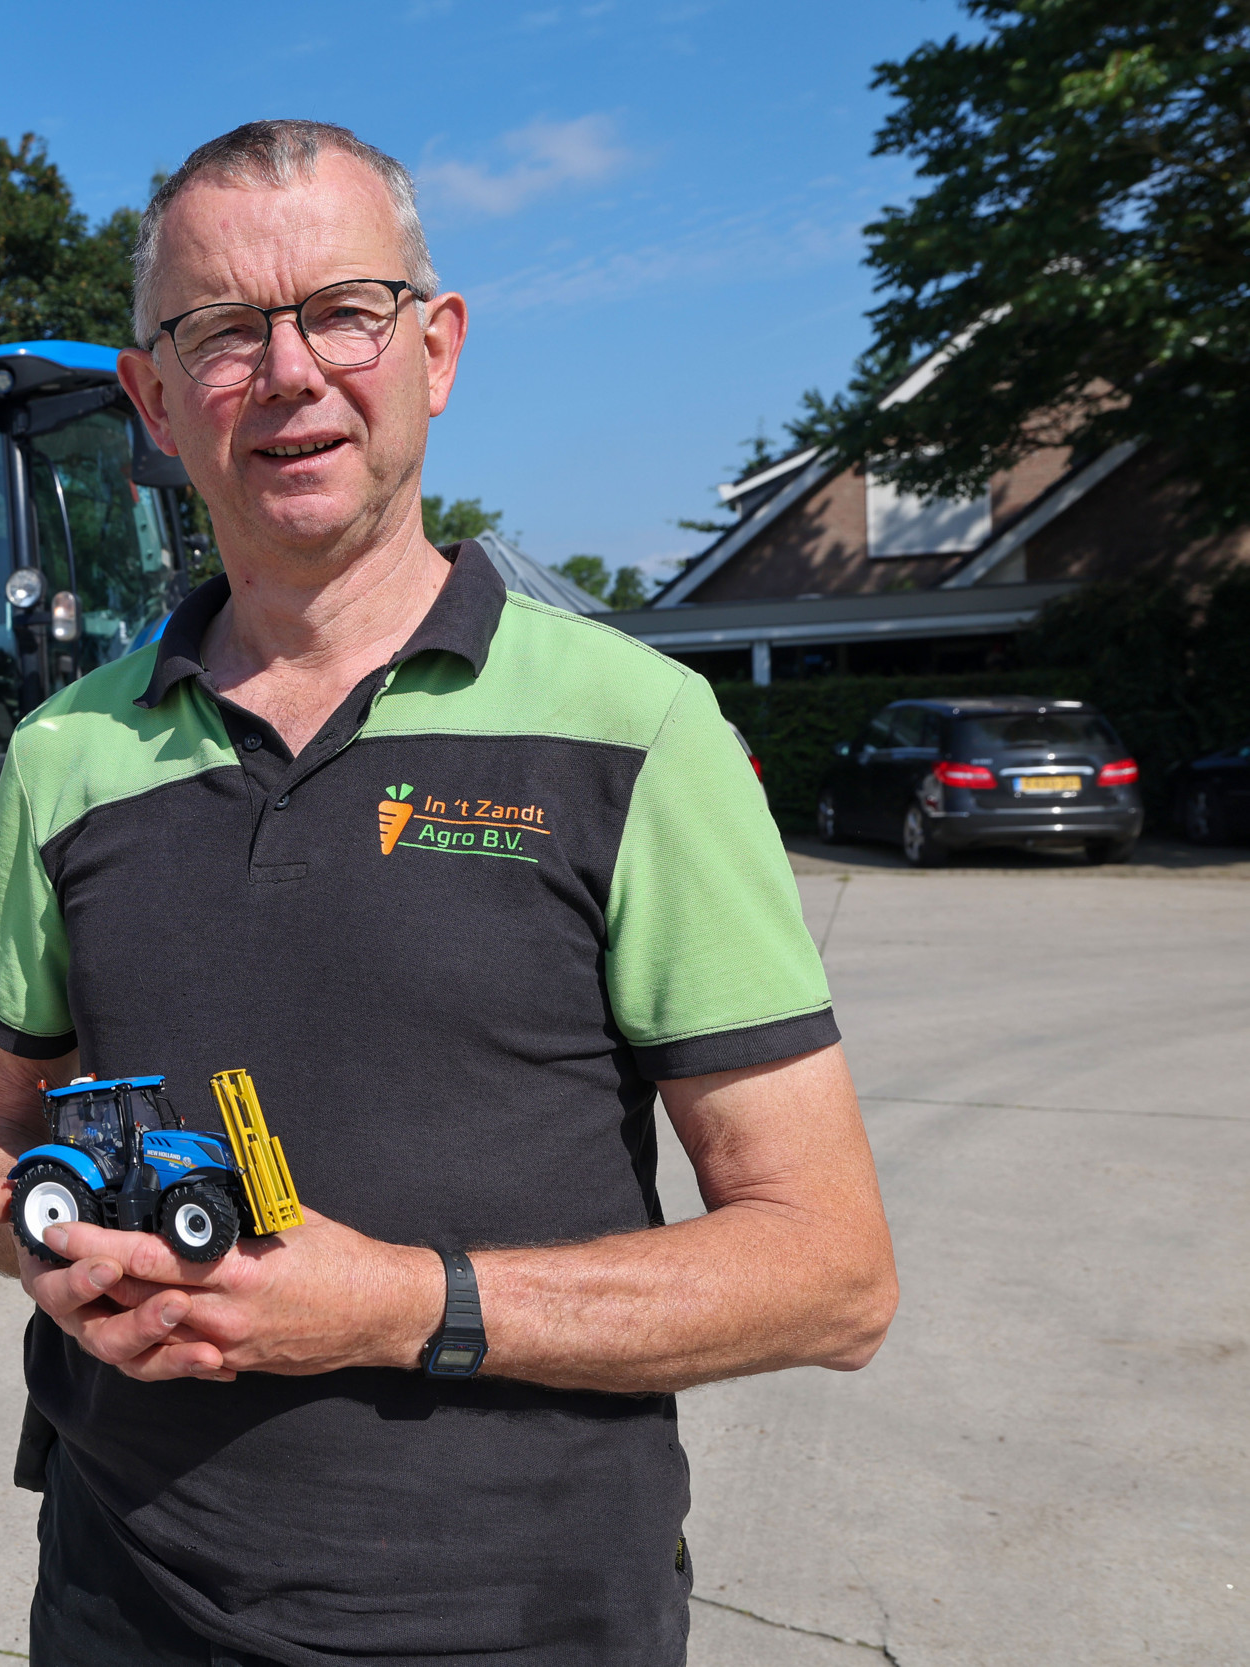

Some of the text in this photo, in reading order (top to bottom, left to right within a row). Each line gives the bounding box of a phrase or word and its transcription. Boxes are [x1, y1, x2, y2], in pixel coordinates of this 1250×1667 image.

[424, 795, 446, 814] In
[474, 800, 545, 824] Zandt
[418, 824, 523, 851] Agro B.V.
[158, 1150, 181, 1160] HOLLAND
